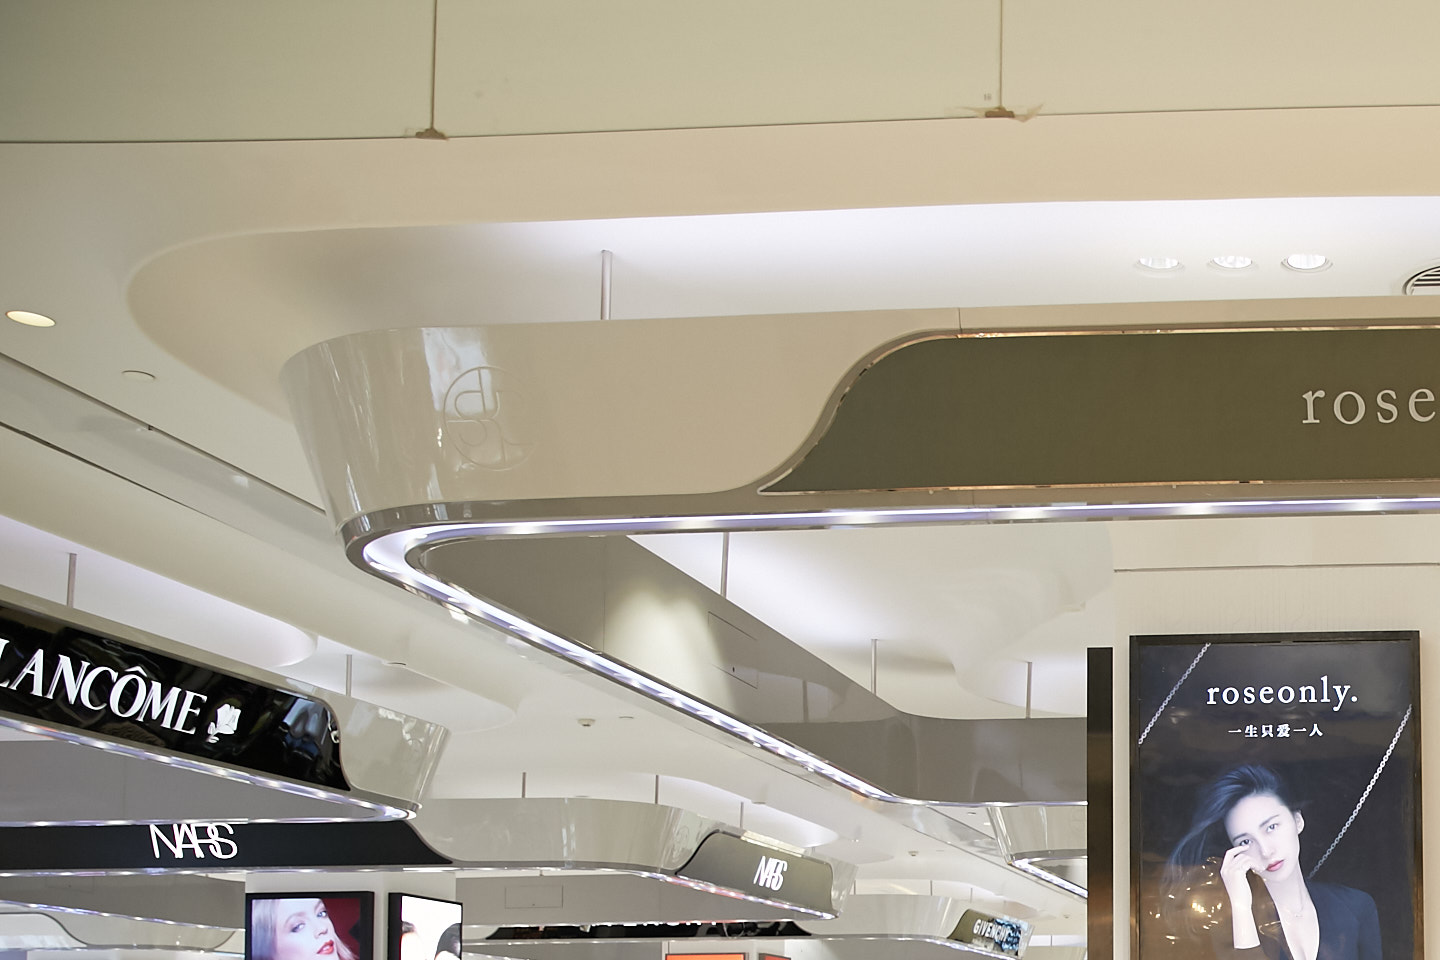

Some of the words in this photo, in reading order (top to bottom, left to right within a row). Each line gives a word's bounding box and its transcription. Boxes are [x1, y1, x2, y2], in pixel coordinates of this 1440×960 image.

[1206, 675, 1358, 712] roseonly.
[1227, 723, 1324, 738] 一生只爱一人
[149, 823, 238, 859] NARS
